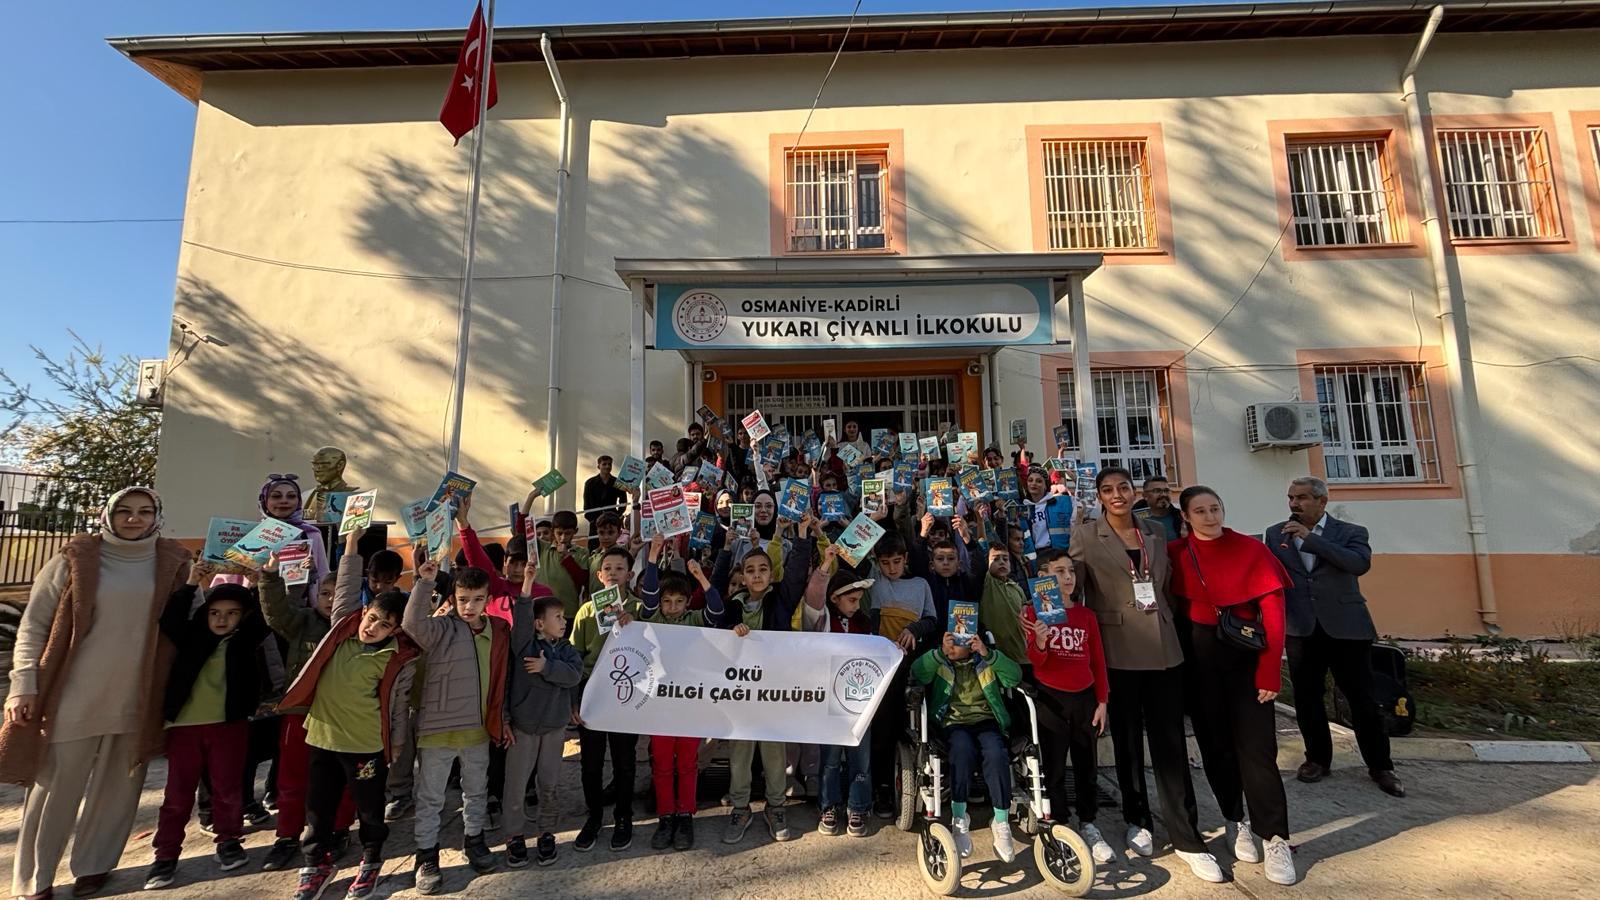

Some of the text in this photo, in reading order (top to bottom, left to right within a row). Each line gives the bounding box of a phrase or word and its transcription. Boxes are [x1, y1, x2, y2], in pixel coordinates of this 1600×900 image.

[741, 294, 900, 313] OSMANİYE-KADİRLİ
[742, 314, 1022, 341] YUKARI ÇİYANLI İLKOKULU
[725, 665, 763, 682] OKÜ
[657, 681, 826, 703] BİLGİ ÇAĞI KULÜBÜ
